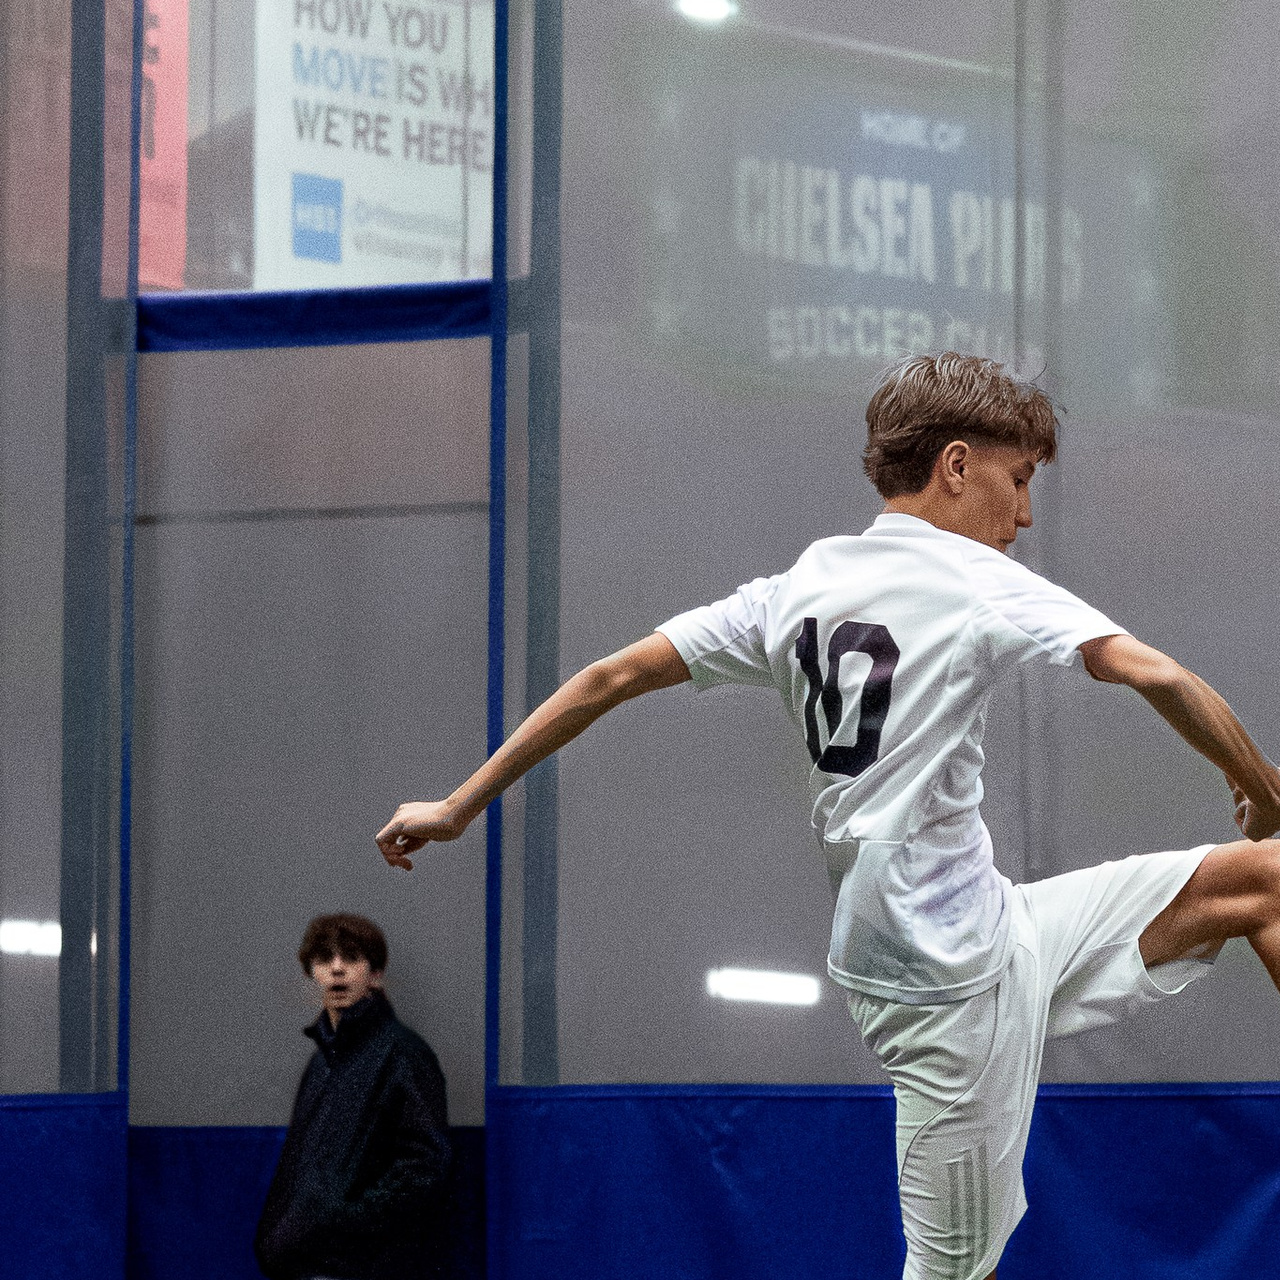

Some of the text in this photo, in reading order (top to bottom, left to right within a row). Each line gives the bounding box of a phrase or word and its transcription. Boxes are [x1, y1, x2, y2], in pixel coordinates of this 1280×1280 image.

[382, 0, 450, 55] YOU
[291, 42, 491, 118] MOVE IS WH
[292, 97, 392, 158] WE'RE
[734, 154, 936, 284] CHELSEA
[767, 305, 933, 360] SOCCER
[795, 617, 900, 779] 10
